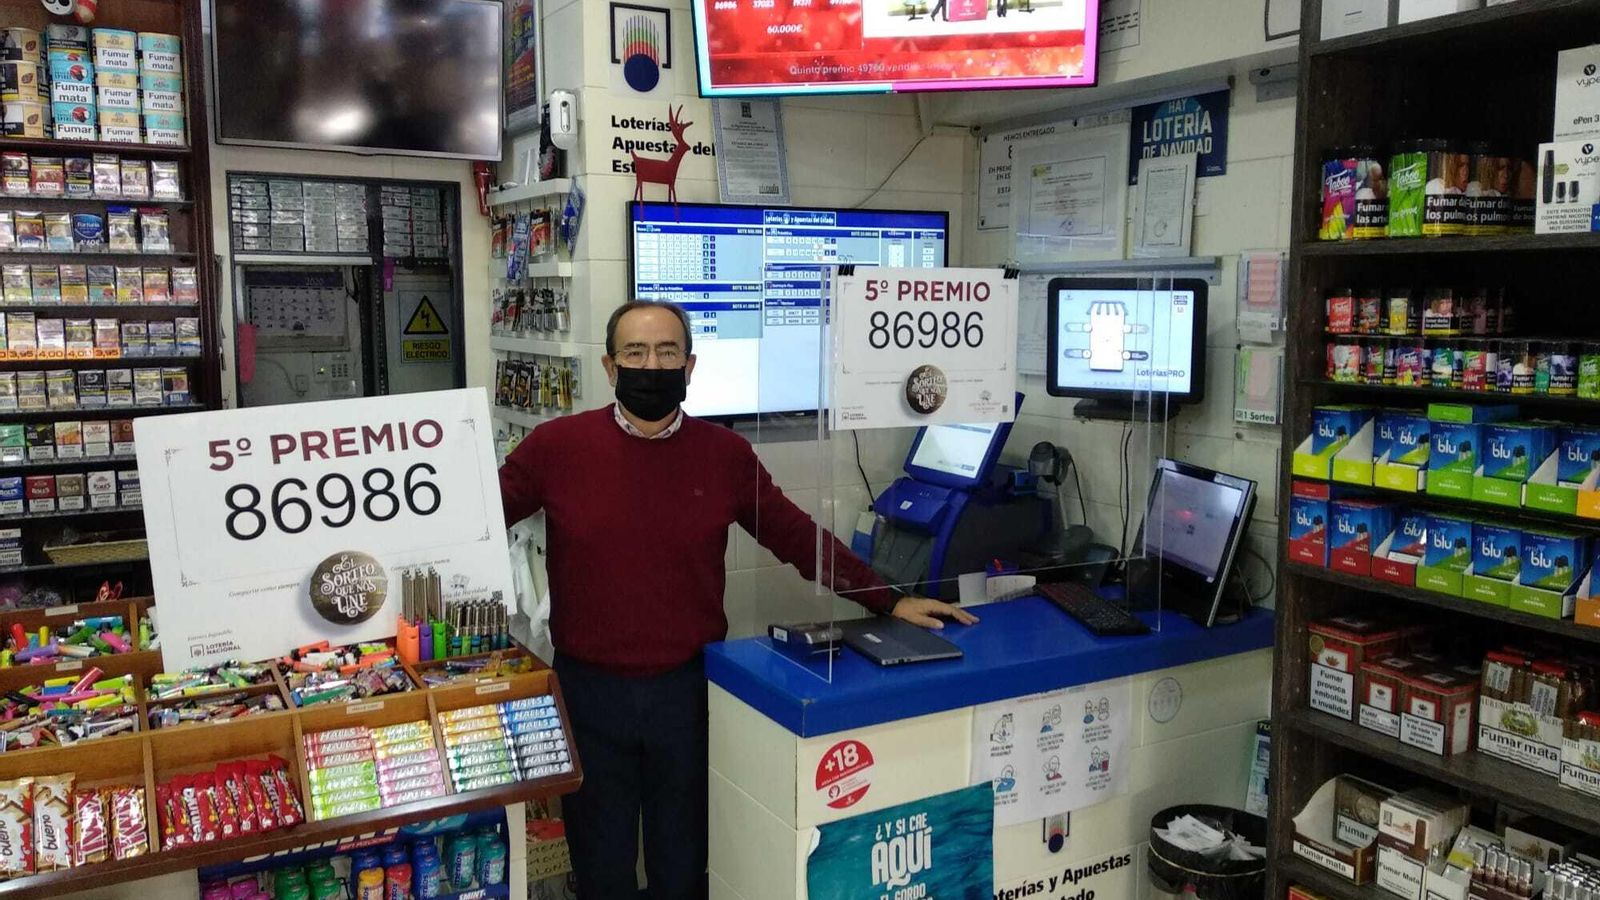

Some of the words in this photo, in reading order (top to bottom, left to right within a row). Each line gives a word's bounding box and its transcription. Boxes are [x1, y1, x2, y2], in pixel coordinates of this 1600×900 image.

[767, 24, 803, 34] 60.000€
[102, 49, 129, 59] Fumar
[149, 53, 176, 62] Fumar
[105, 59, 128, 68] mata
[152, 62, 174, 71] mata
[789, 64, 821, 75] Quinto
[55, 82, 90, 92] Fumar
[104, 89, 132, 98] Fumar
[59, 93, 87, 103] mata
[107, 98, 130, 106] mata
[149, 92, 176, 101] Fumar
[152, 101, 174, 109] mata
[1168, 99, 1187, 113] HAY
[58, 124, 92, 134] Fumar
[611, 115, 672, 132] Loterías
[1143, 107, 1213, 144] LOTERÍA
[107, 128, 134, 137] Fumar
[153, 130, 179, 139] Fumar
[1022, 127, 1055, 139] ENTREGADO
[612, 137, 677, 153] Apuesta
[1143, 147, 1156, 159] DE
[1161, 137, 1213, 157] NAVIDAD
[1357, 203, 1385, 212] Fumar
[1427, 197, 1457, 207] Fumar
[1356, 214, 1370, 224] las
[1426, 210, 1441, 220] los
[865, 280, 889, 302] 5º
[898, 280, 991, 302] PREMIO
[868, 310, 984, 349] 86986
[412, 342, 441, 350] RIESGO
[1249, 411, 1275, 422] Sorteo
[1319, 424, 1335, 438] blu
[1400, 430, 1417, 445] blu
[209, 437, 252, 472] 5º
[270, 419, 443, 465] PREMIO
[1437, 438, 1456, 454] blu
[1492, 443, 1511, 459] blu
[1567, 446, 1589, 462] blu
[224, 463, 442, 541] 86986
[1297, 512, 1312, 526] blu
[1338, 518, 1355, 534] blu
[1403, 522, 1422, 537] blu
[1434, 533, 1452, 549] blu
[1481, 541, 1502, 558] blu
[1531, 550, 1552, 568] blu
[320, 563, 376, 595] SORTEO
[335, 585, 354, 596] QUE
[356, 579, 377, 593] NOS
[330, 592, 369, 618] UNE
[206, 640, 233, 650] LOTERÍA
[207, 645, 241, 655] NACIONAL
[1320, 669, 1343, 684] Fumar
[1316, 680, 1346, 695] provoca
[512, 697, 543, 709] HALLS
[1318, 700, 1350, 716] invalidez
[515, 709, 546, 720] HALLS
[517, 719, 548, 731] HALLS
[520, 731, 552, 743] HALLS
[1480, 727, 1522, 748] Fumar
[1523, 743, 1559, 761] mata
[523, 741, 554, 753] HALLS
[525, 754, 557, 767] HALLS
[824, 744, 860, 772] +18
[529, 765, 560, 778] HALLS
[896, 818, 906, 836] SI
[909, 812, 928, 831] CAE
[1339, 820, 1369, 841] Fumar
[42, 814, 59, 850] bueno
[871, 826, 934, 891] AQUÍ
[1299, 844, 1324, 862] Fumar
[1325, 857, 1347, 873] mata
[1050, 875, 1058, 891] y
[1062, 853, 1131, 885] Apuestas
[1379, 861, 1401, 877] Fumar
[894, 883, 927, 900] GORDO
